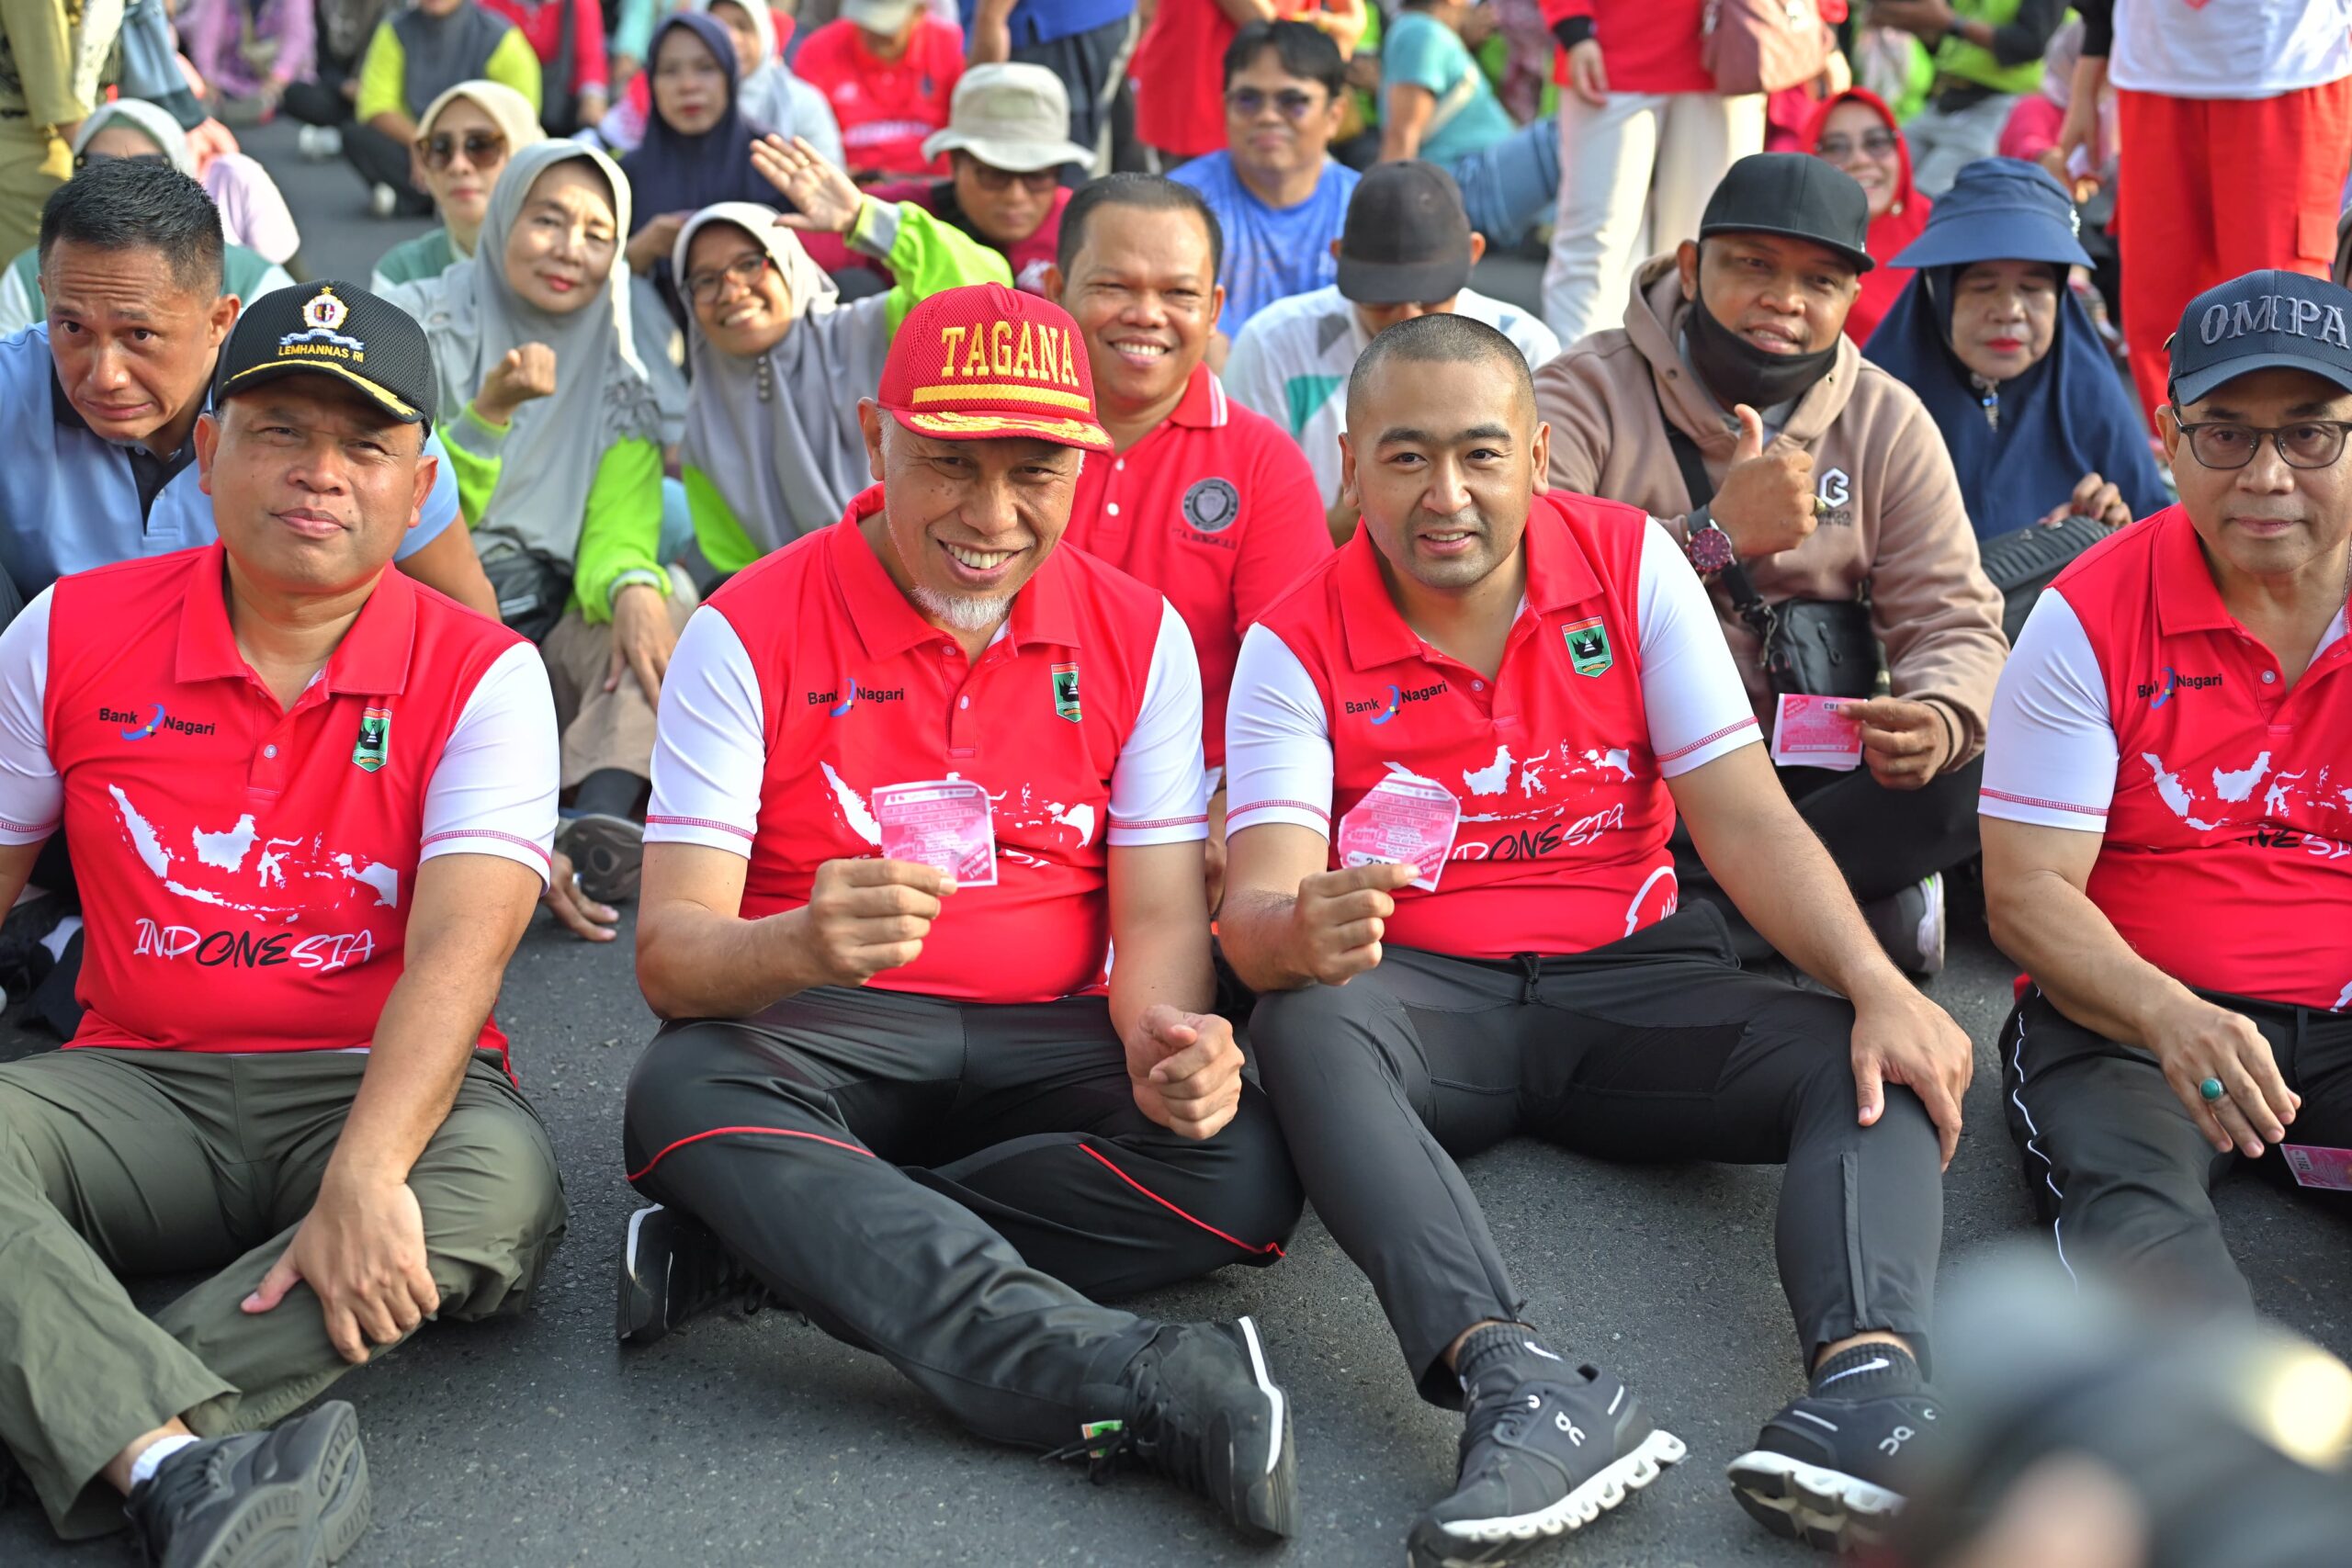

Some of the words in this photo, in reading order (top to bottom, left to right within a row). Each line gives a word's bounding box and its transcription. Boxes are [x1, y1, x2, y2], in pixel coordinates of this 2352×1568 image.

[2199, 294, 2350, 350] OMPA
[278, 344, 350, 359] LEMHANNAS
[358, 350, 365, 364] RI
[941, 321, 1080, 387] TAGANA
[856, 687, 905, 704] Nagari
[1345, 697, 1380, 715] Bank
[1401, 680, 1449, 705] Nagari
[2176, 673, 2222, 690] Nagari
[98, 707, 139, 725] Bank
[163, 716, 216, 736] Nagari
[133, 918, 376, 972] INDONESIA
